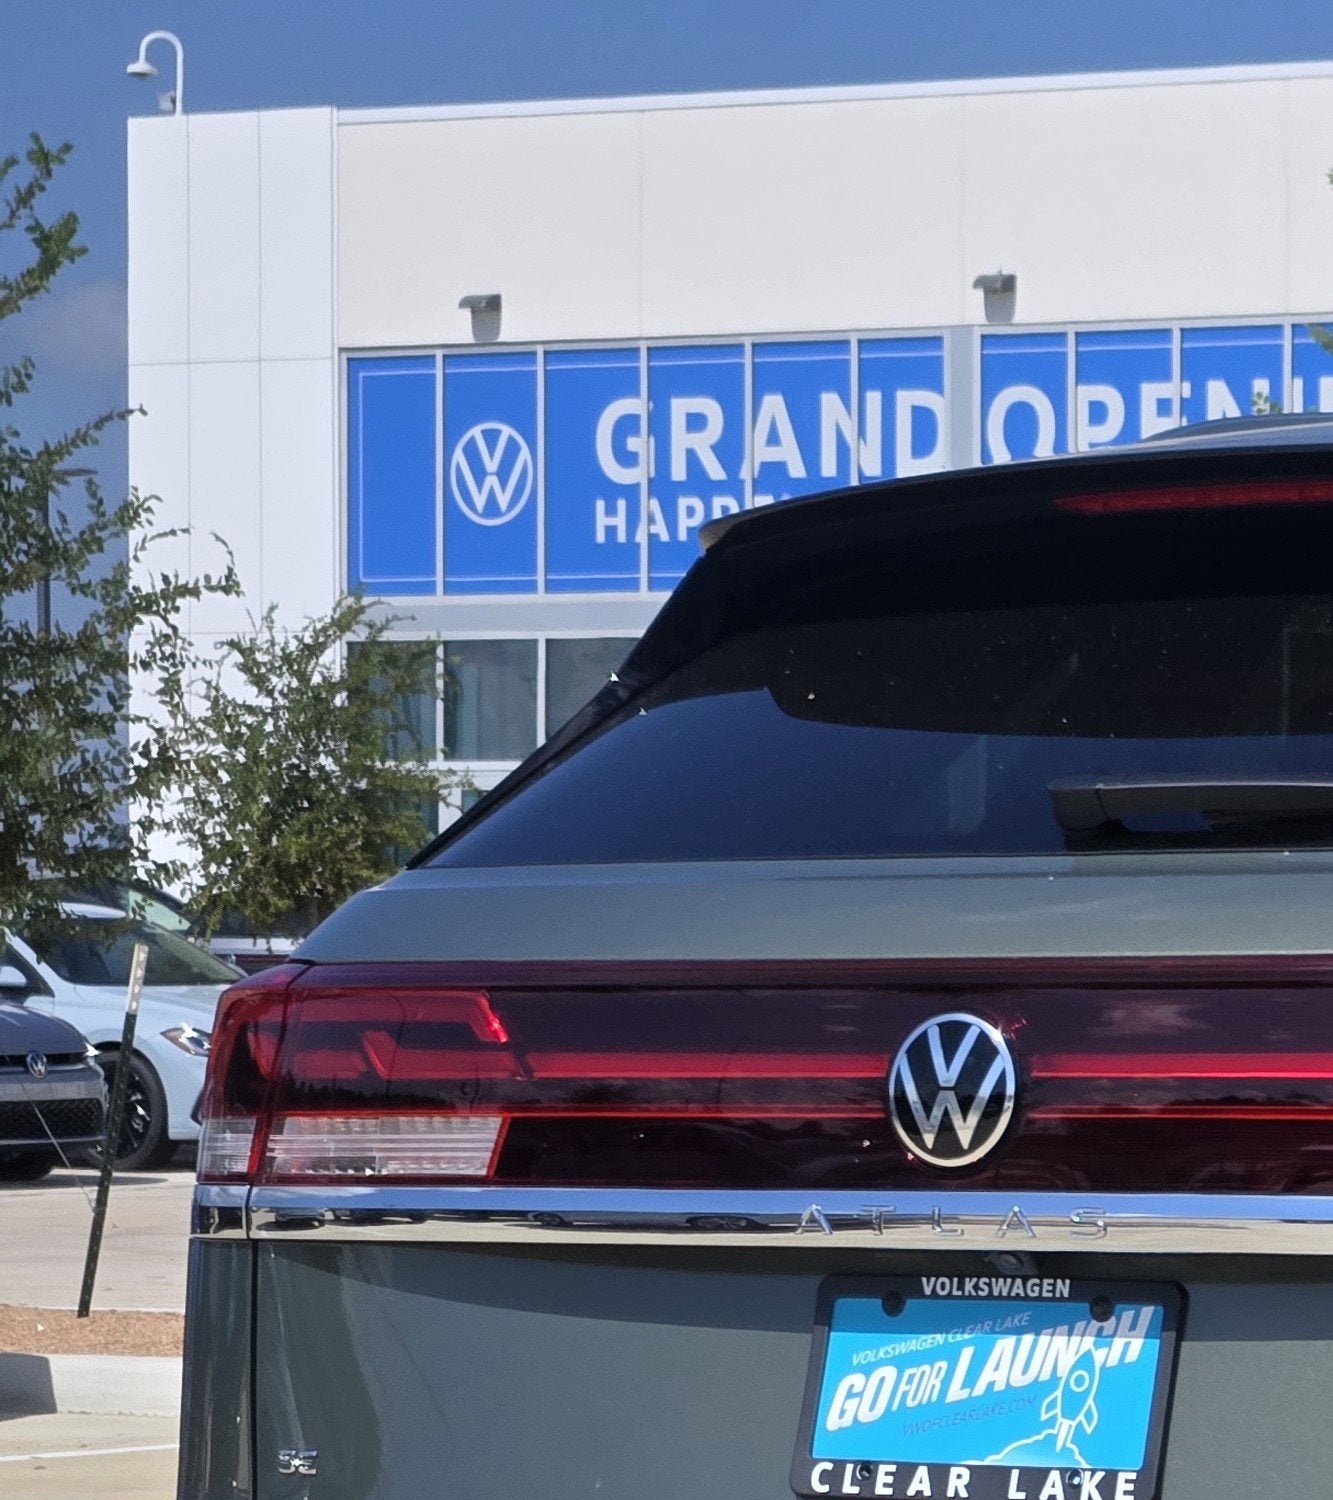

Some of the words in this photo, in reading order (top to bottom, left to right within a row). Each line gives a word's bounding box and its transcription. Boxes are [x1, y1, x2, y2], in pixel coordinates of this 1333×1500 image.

[596, 388, 944, 485] GRAND
[795, 1203, 1107, 1240] ATLAS
[921, 1276, 1071, 1298] VOLKSWAGEN
[851, 1332, 946, 1366] VOLKSWAGEN
[947, 1321, 993, 1344] CLEAR
[994, 1311, 1032, 1332] LAKE
[825, 1365, 898, 1431] GO
[891, 1360, 948, 1412] FOR
[945, 1305, 1155, 1403] LAUNCH
[810, 1462, 971, 1499] CLEAR
